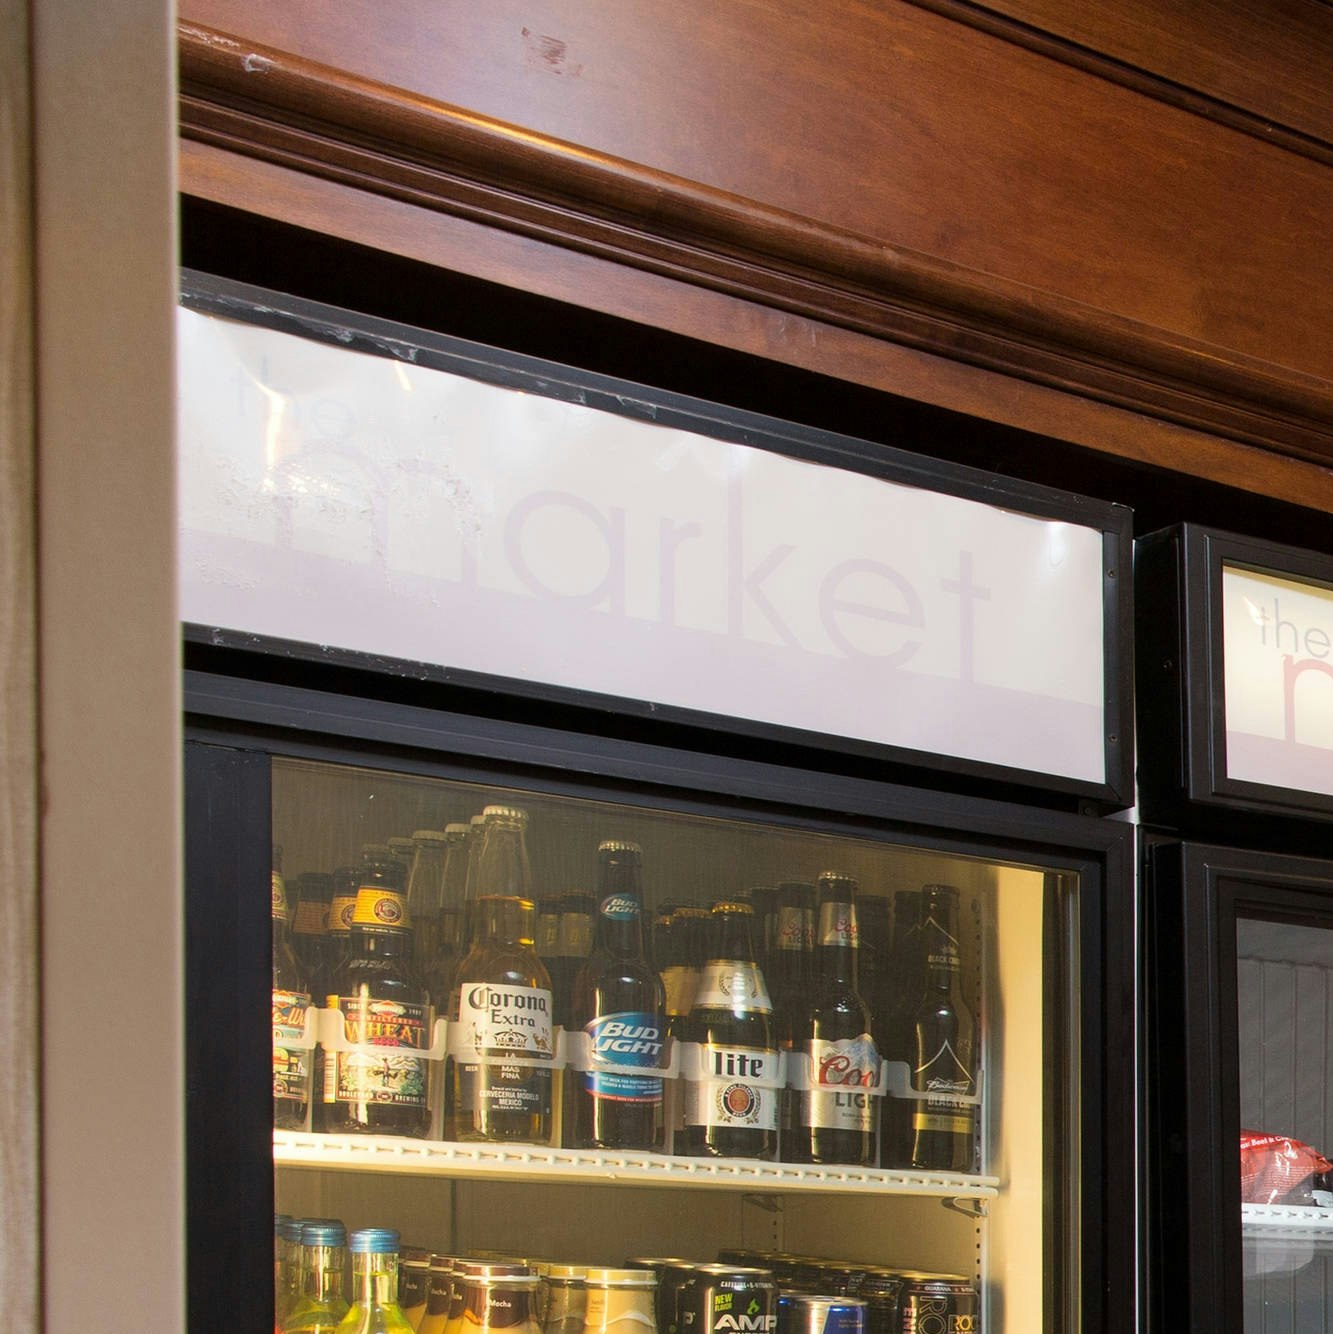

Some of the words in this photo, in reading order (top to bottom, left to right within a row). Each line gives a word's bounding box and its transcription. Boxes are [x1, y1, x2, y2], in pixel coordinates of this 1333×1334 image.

[274, 443, 990, 685] market
[1257, 599, 1331, 658] the
[604, 905, 640, 914] LIGHT
[611, 898, 638, 908] BUD
[468, 984, 548, 1014] Corona
[492, 1009, 536, 1028] Extra
[344, 1021, 426, 1049] WHEAT
[600, 1022, 660, 1040] BUD
[594, 1038, 663, 1056] LIGHT
[714, 1051, 764, 1078] lite
[502, 1072, 520, 1080] FINA
[499, 1098, 523, 1107] MEXICO
[489, 1299, 512, 1308] Mocha
[715, 1293, 733, 1304] NEW
[714, 1315, 778, 1330] AMP
